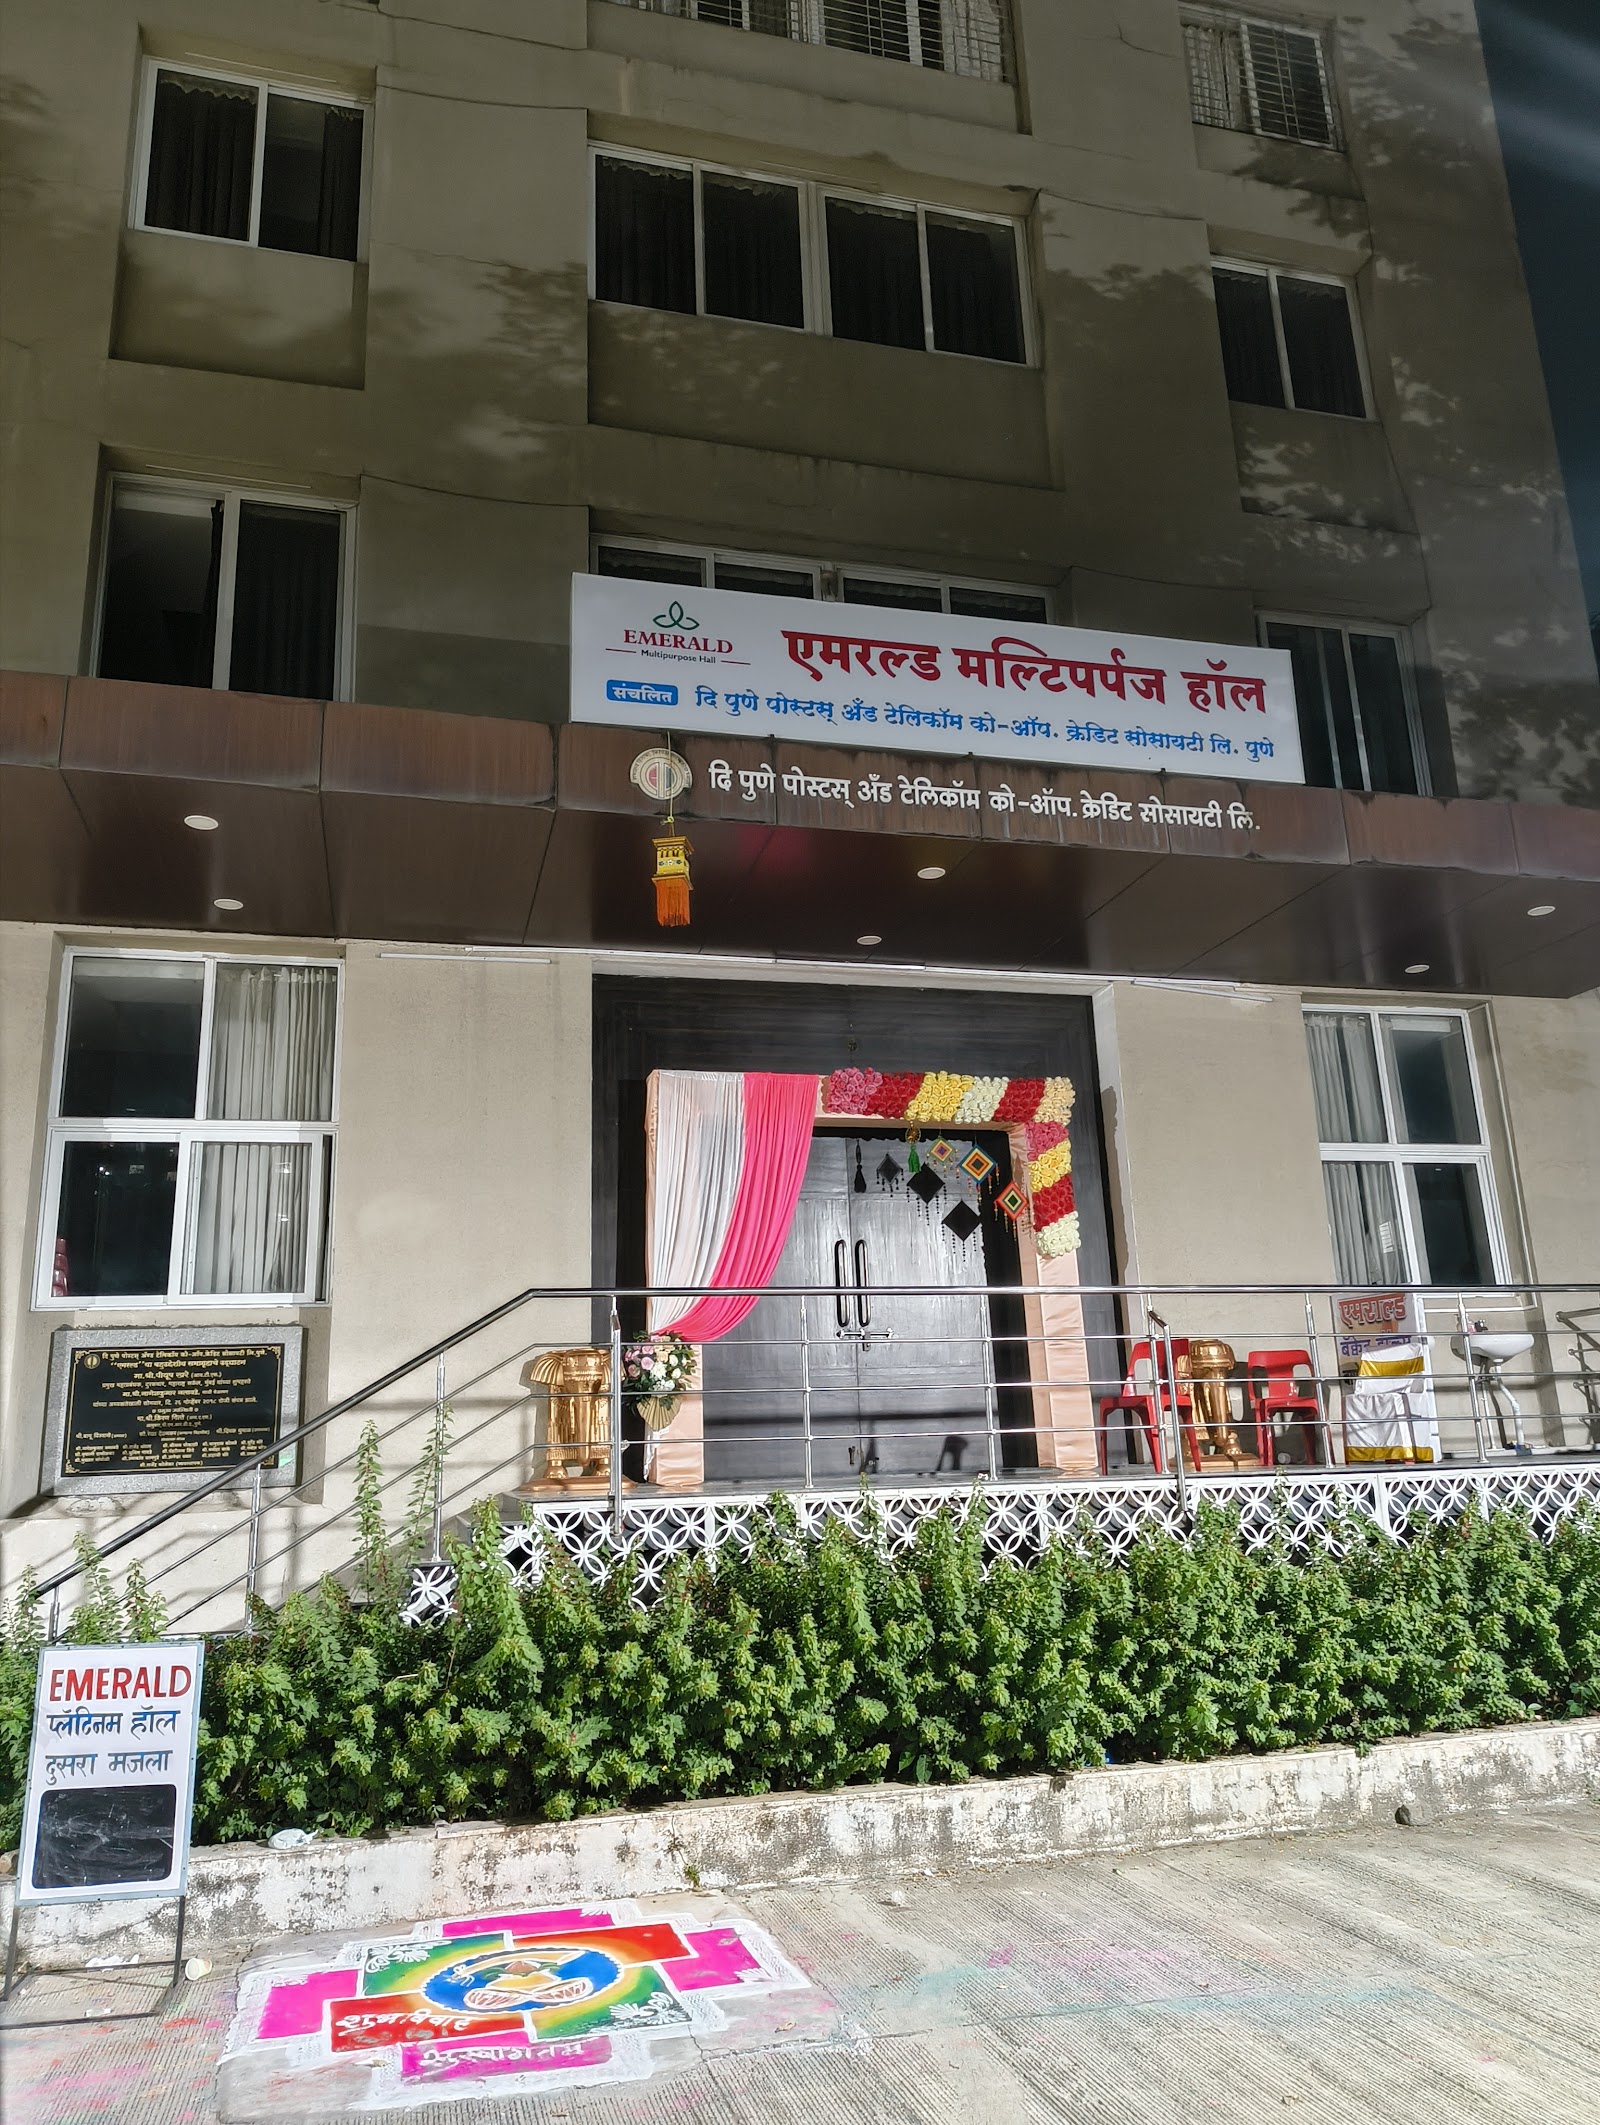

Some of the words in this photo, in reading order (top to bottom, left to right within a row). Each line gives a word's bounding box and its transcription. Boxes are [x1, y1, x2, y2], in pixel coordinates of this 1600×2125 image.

[623, 629, 734, 654] EMERALD
[640, 649, 698, 663] Multipurpose
[699, 653, 717, 665] Hall
[780, 630, 942, 682] एमरल्ड
[951, 636, 1168, 705] मल्टिपर्पज
[1180, 658, 1268, 714] हॉल
[611, 683, 675, 705] संचलित
[694, 685, 718, 708] दि
[724, 690, 760, 717] पुणे
[885, 700, 964, 731] टेलिकॉम
[1065, 719, 1119, 745] क्रेडिट
[1125, 725, 1203, 753] सोसायटी
[1245, 737, 1274, 763] पुणे
[708, 759, 733, 792] दि
[738, 762, 776, 802] पुणे
[896, 774, 981, 810] टेलिकॉम
[1137, 795, 1223, 829] सोसायटी
[49, 1665, 192, 1702] EMERALD
[131, 1705, 181, 1740] हॉल
[45, 1753, 98, 1786] दुसरा
[108, 1750, 174, 1776] मजला
